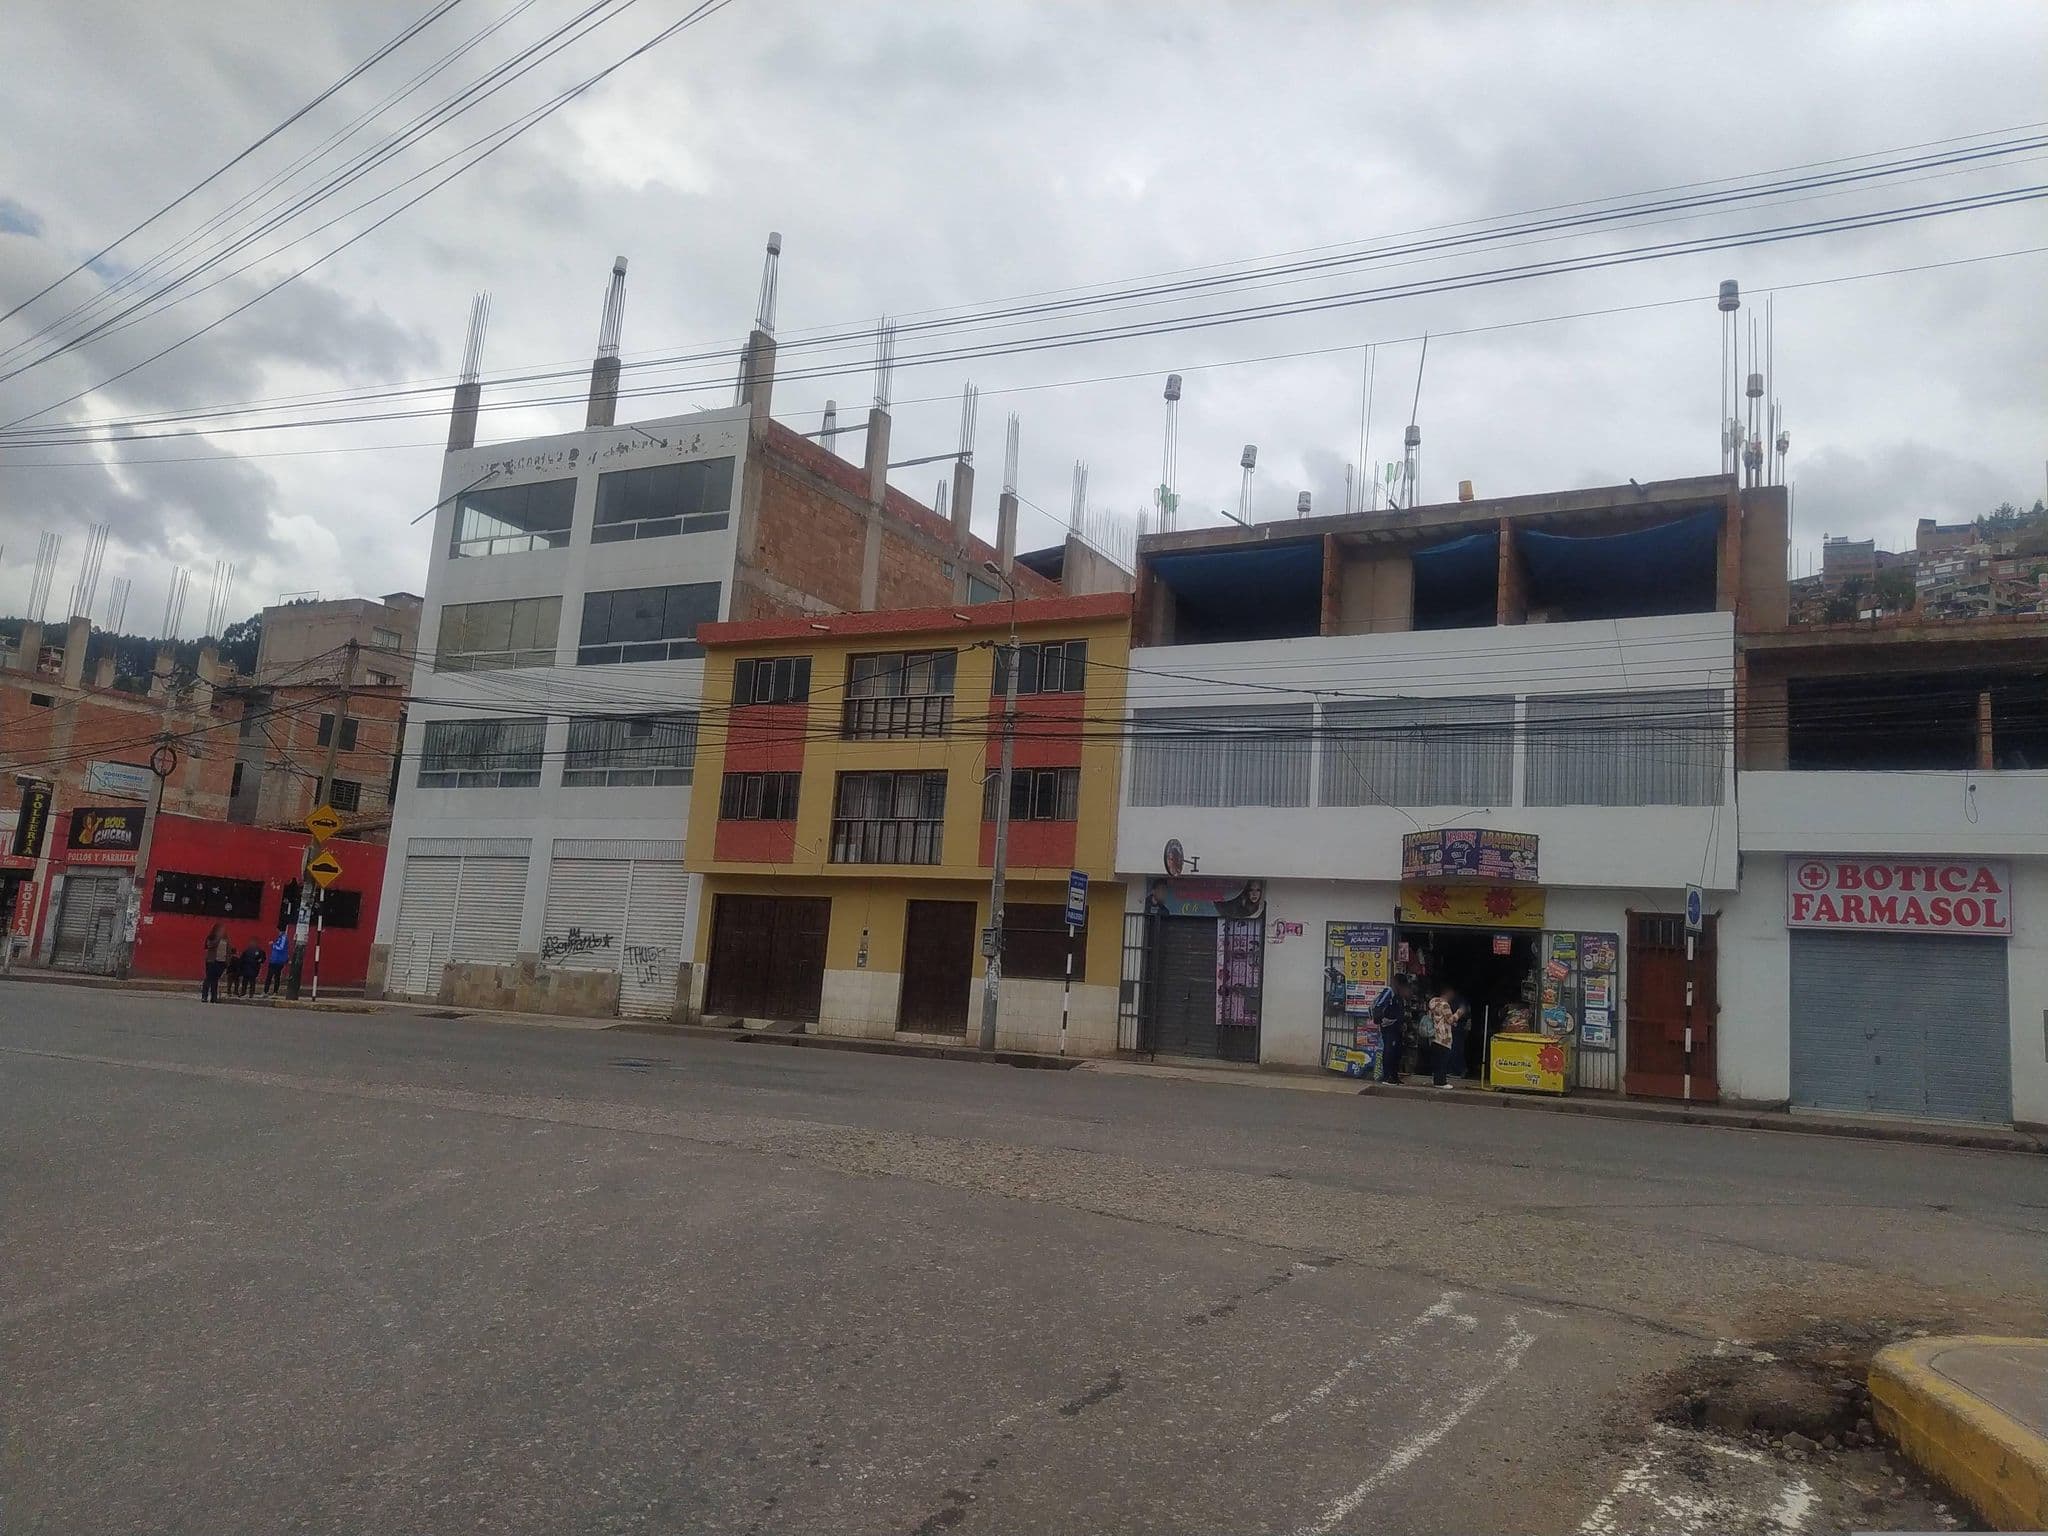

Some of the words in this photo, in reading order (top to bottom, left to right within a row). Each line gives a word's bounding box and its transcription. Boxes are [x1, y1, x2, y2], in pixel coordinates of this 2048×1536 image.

[94, 828, 132, 843] CHICKEN
[1481, 831, 1537, 852] ABARROTES
[67, 851, 92, 861] POLLOS
[94, 852, 101, 861] Y
[1835, 863, 2002, 894] BOTICA
[16, 882, 34, 935] BOTICA
[1792, 892, 2006, 928] FARMASOL
